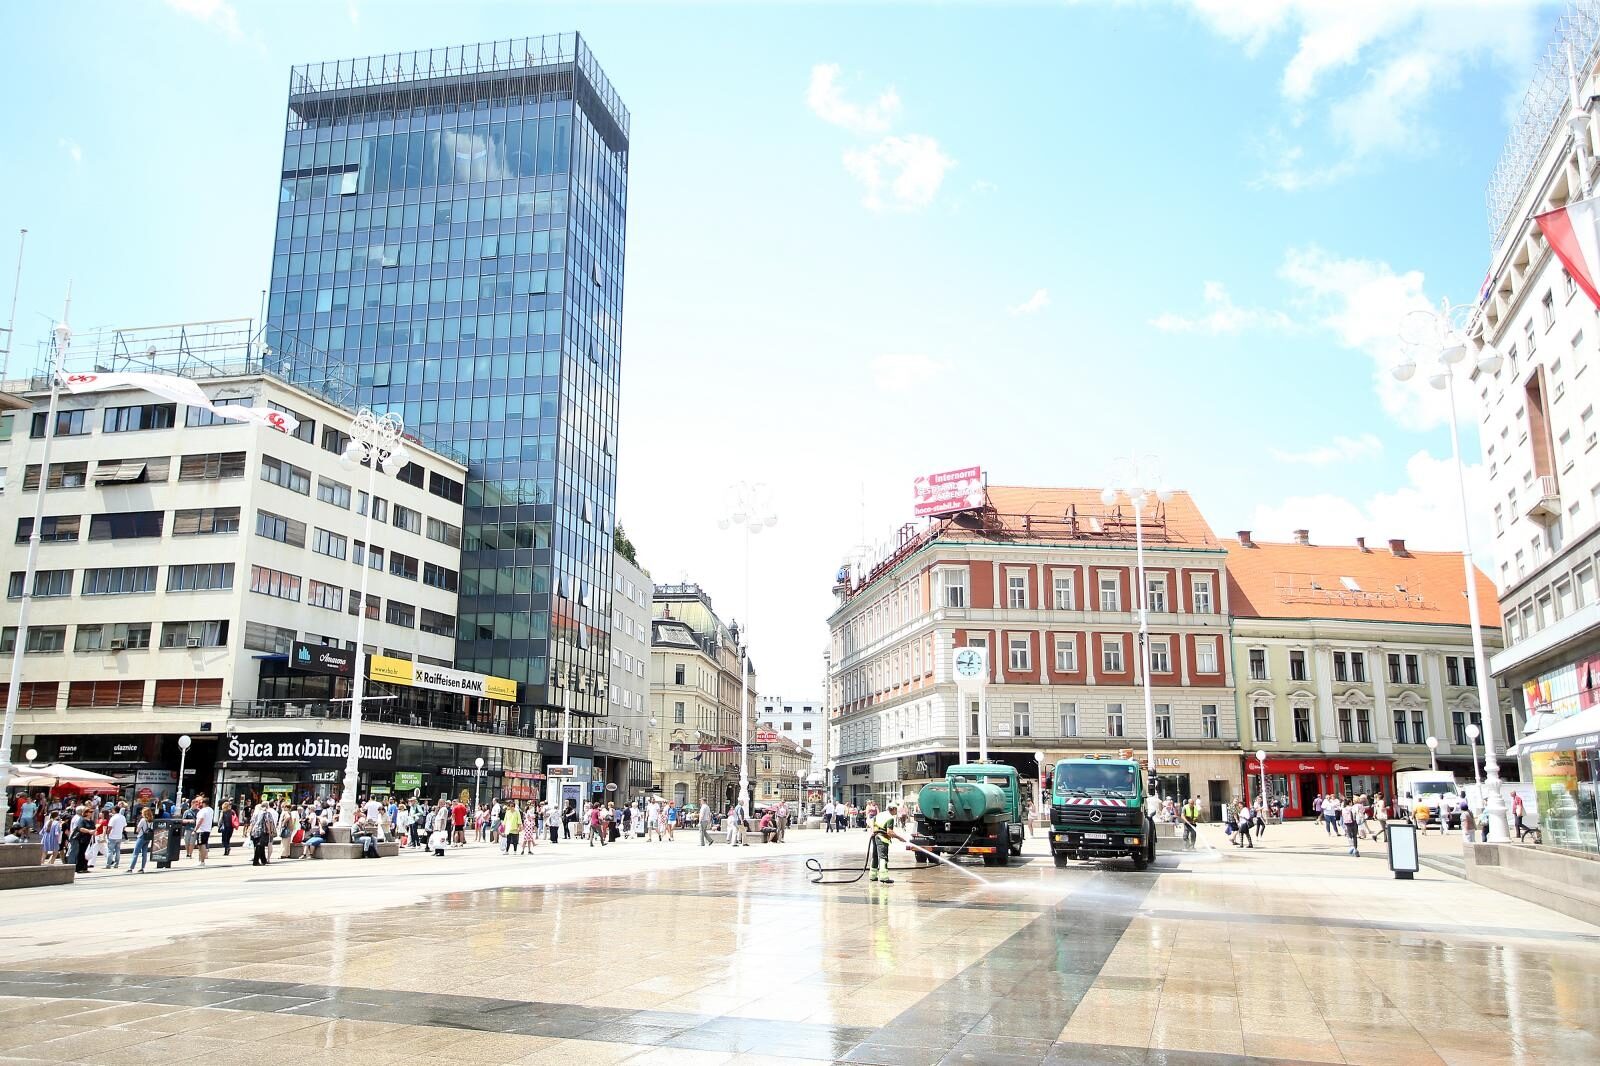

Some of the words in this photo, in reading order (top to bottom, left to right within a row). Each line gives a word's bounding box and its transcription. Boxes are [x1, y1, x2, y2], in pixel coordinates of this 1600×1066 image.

[423, 672, 461, 688] Raiffeisen
[461, 679, 483, 691] BANK
[228, 735, 273, 761] Špica
[277, 739, 349, 758] mobilne
[358, 743, 393, 761] onude
[311, 771, 336, 781] TELE2
